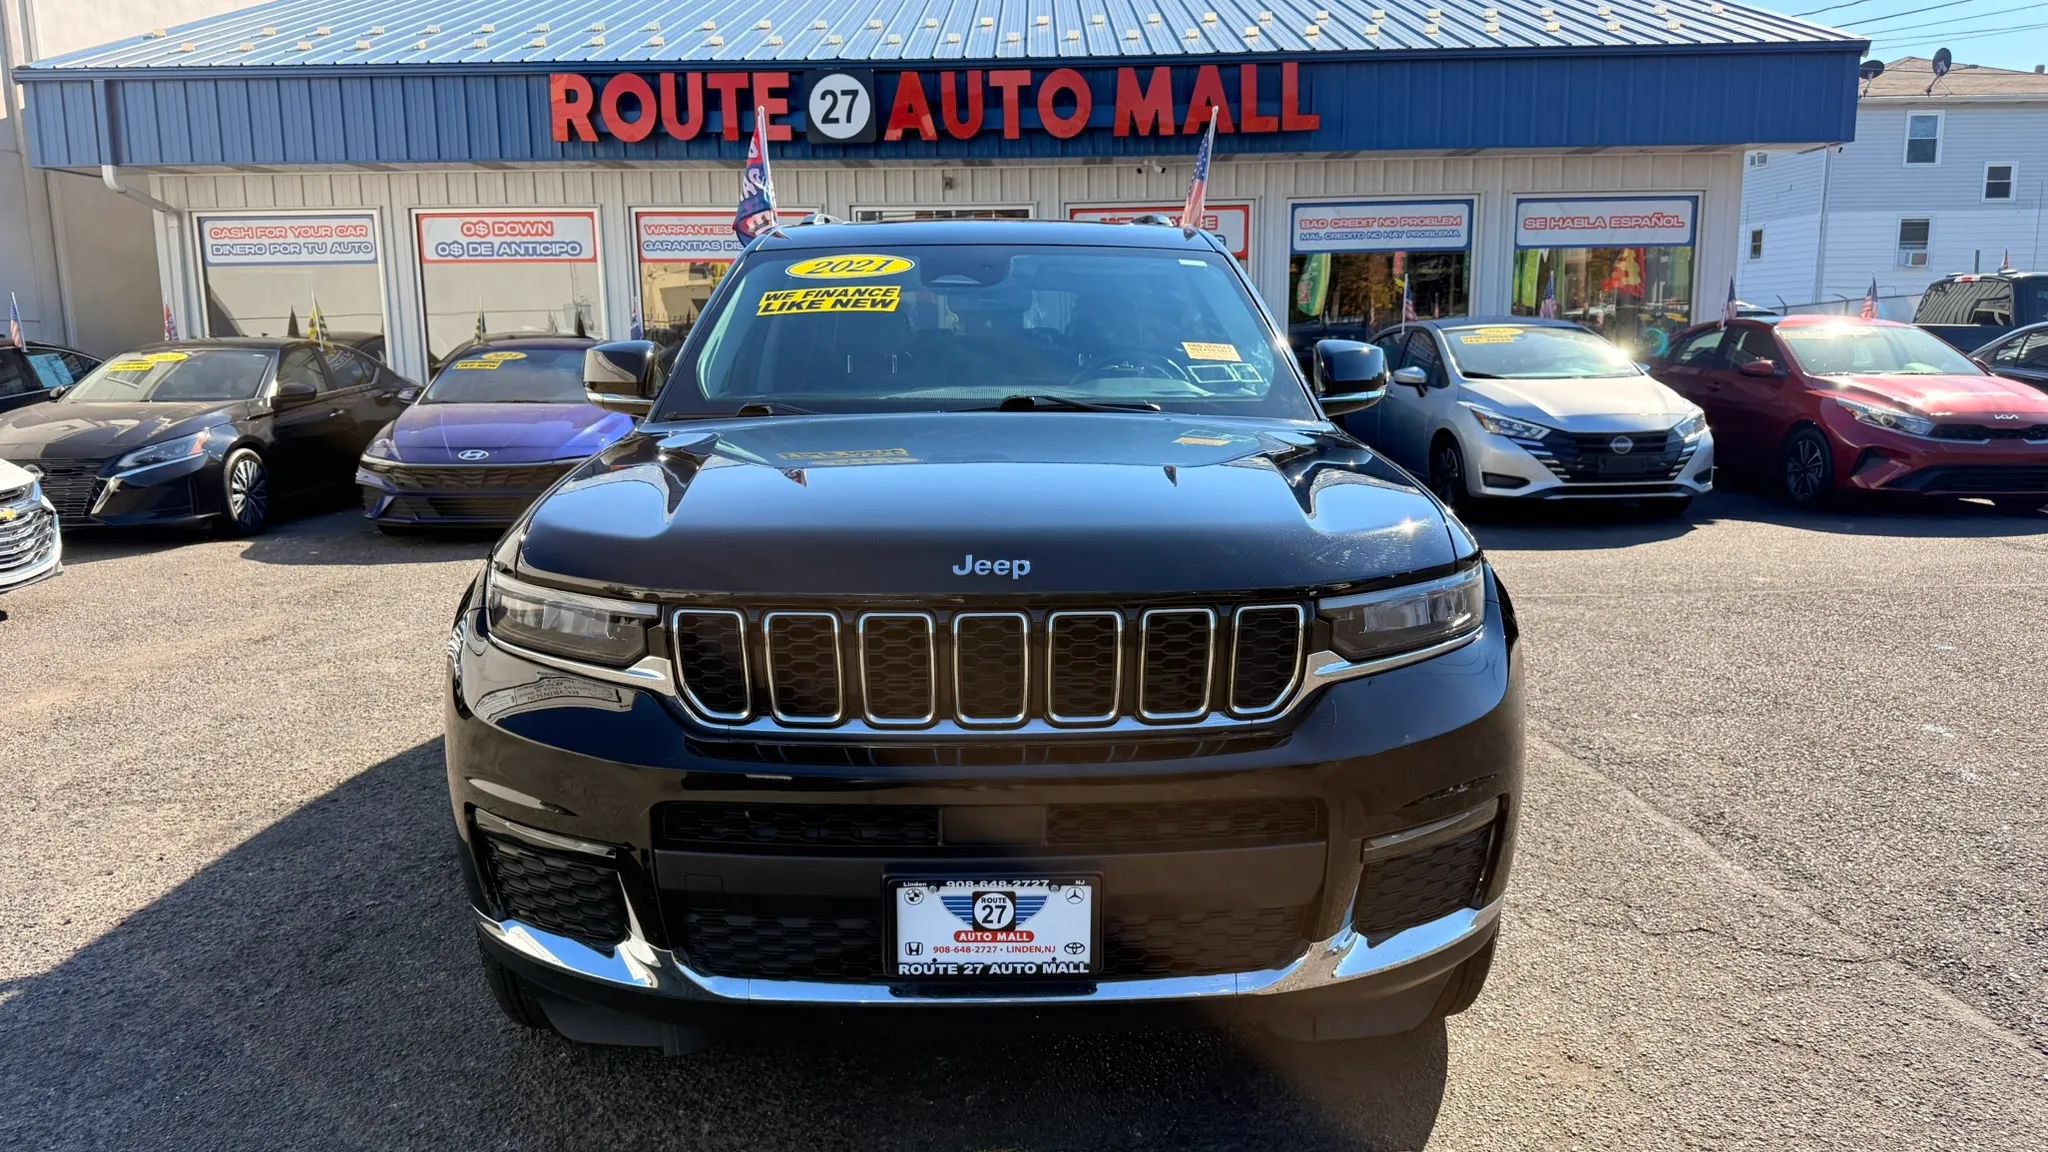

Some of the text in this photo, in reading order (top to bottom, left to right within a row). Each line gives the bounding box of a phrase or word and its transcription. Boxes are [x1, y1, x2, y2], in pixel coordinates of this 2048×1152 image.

[550, 62, 1320, 142] ROUTE 27 AUTO MALL
[1300, 215, 1462, 230] BAD CREDIT NO PROBLEM
[1524, 212, 1685, 230] SE HABLA ESPAÑOL
[210, 225, 368, 240] CASH FOR YOUR CAR
[493, 221, 553, 237] DOWN
[643, 224, 735, 236] WARRANTIES
[1301, 229, 1461, 241] MAL CREDITO NO HAY PROBLEMA
[211, 241, 374, 257] DINERO POR TU AUTO
[467, 241, 496, 257] DE
[496, 241, 582, 257] ANTICIPO
[642, 240, 721, 251] GARANTIAS
[805, 259, 895, 274] 2021
[764, 288, 898, 301] WE FINANCE
[761, 298, 895, 313] LIKE NEW
[952, 554, 1031, 579] Jeep
[946, 880, 1049, 889] 908-648-2727
[981, 905, 1007, 924] 27
[959, 932, 1030, 941] AUTO MALL
[933, 945, 1056, 955] 908-648-2727 LINDEN,NJ
[898, 962, 1089, 975] ROUTE 27 AUTO MALL
